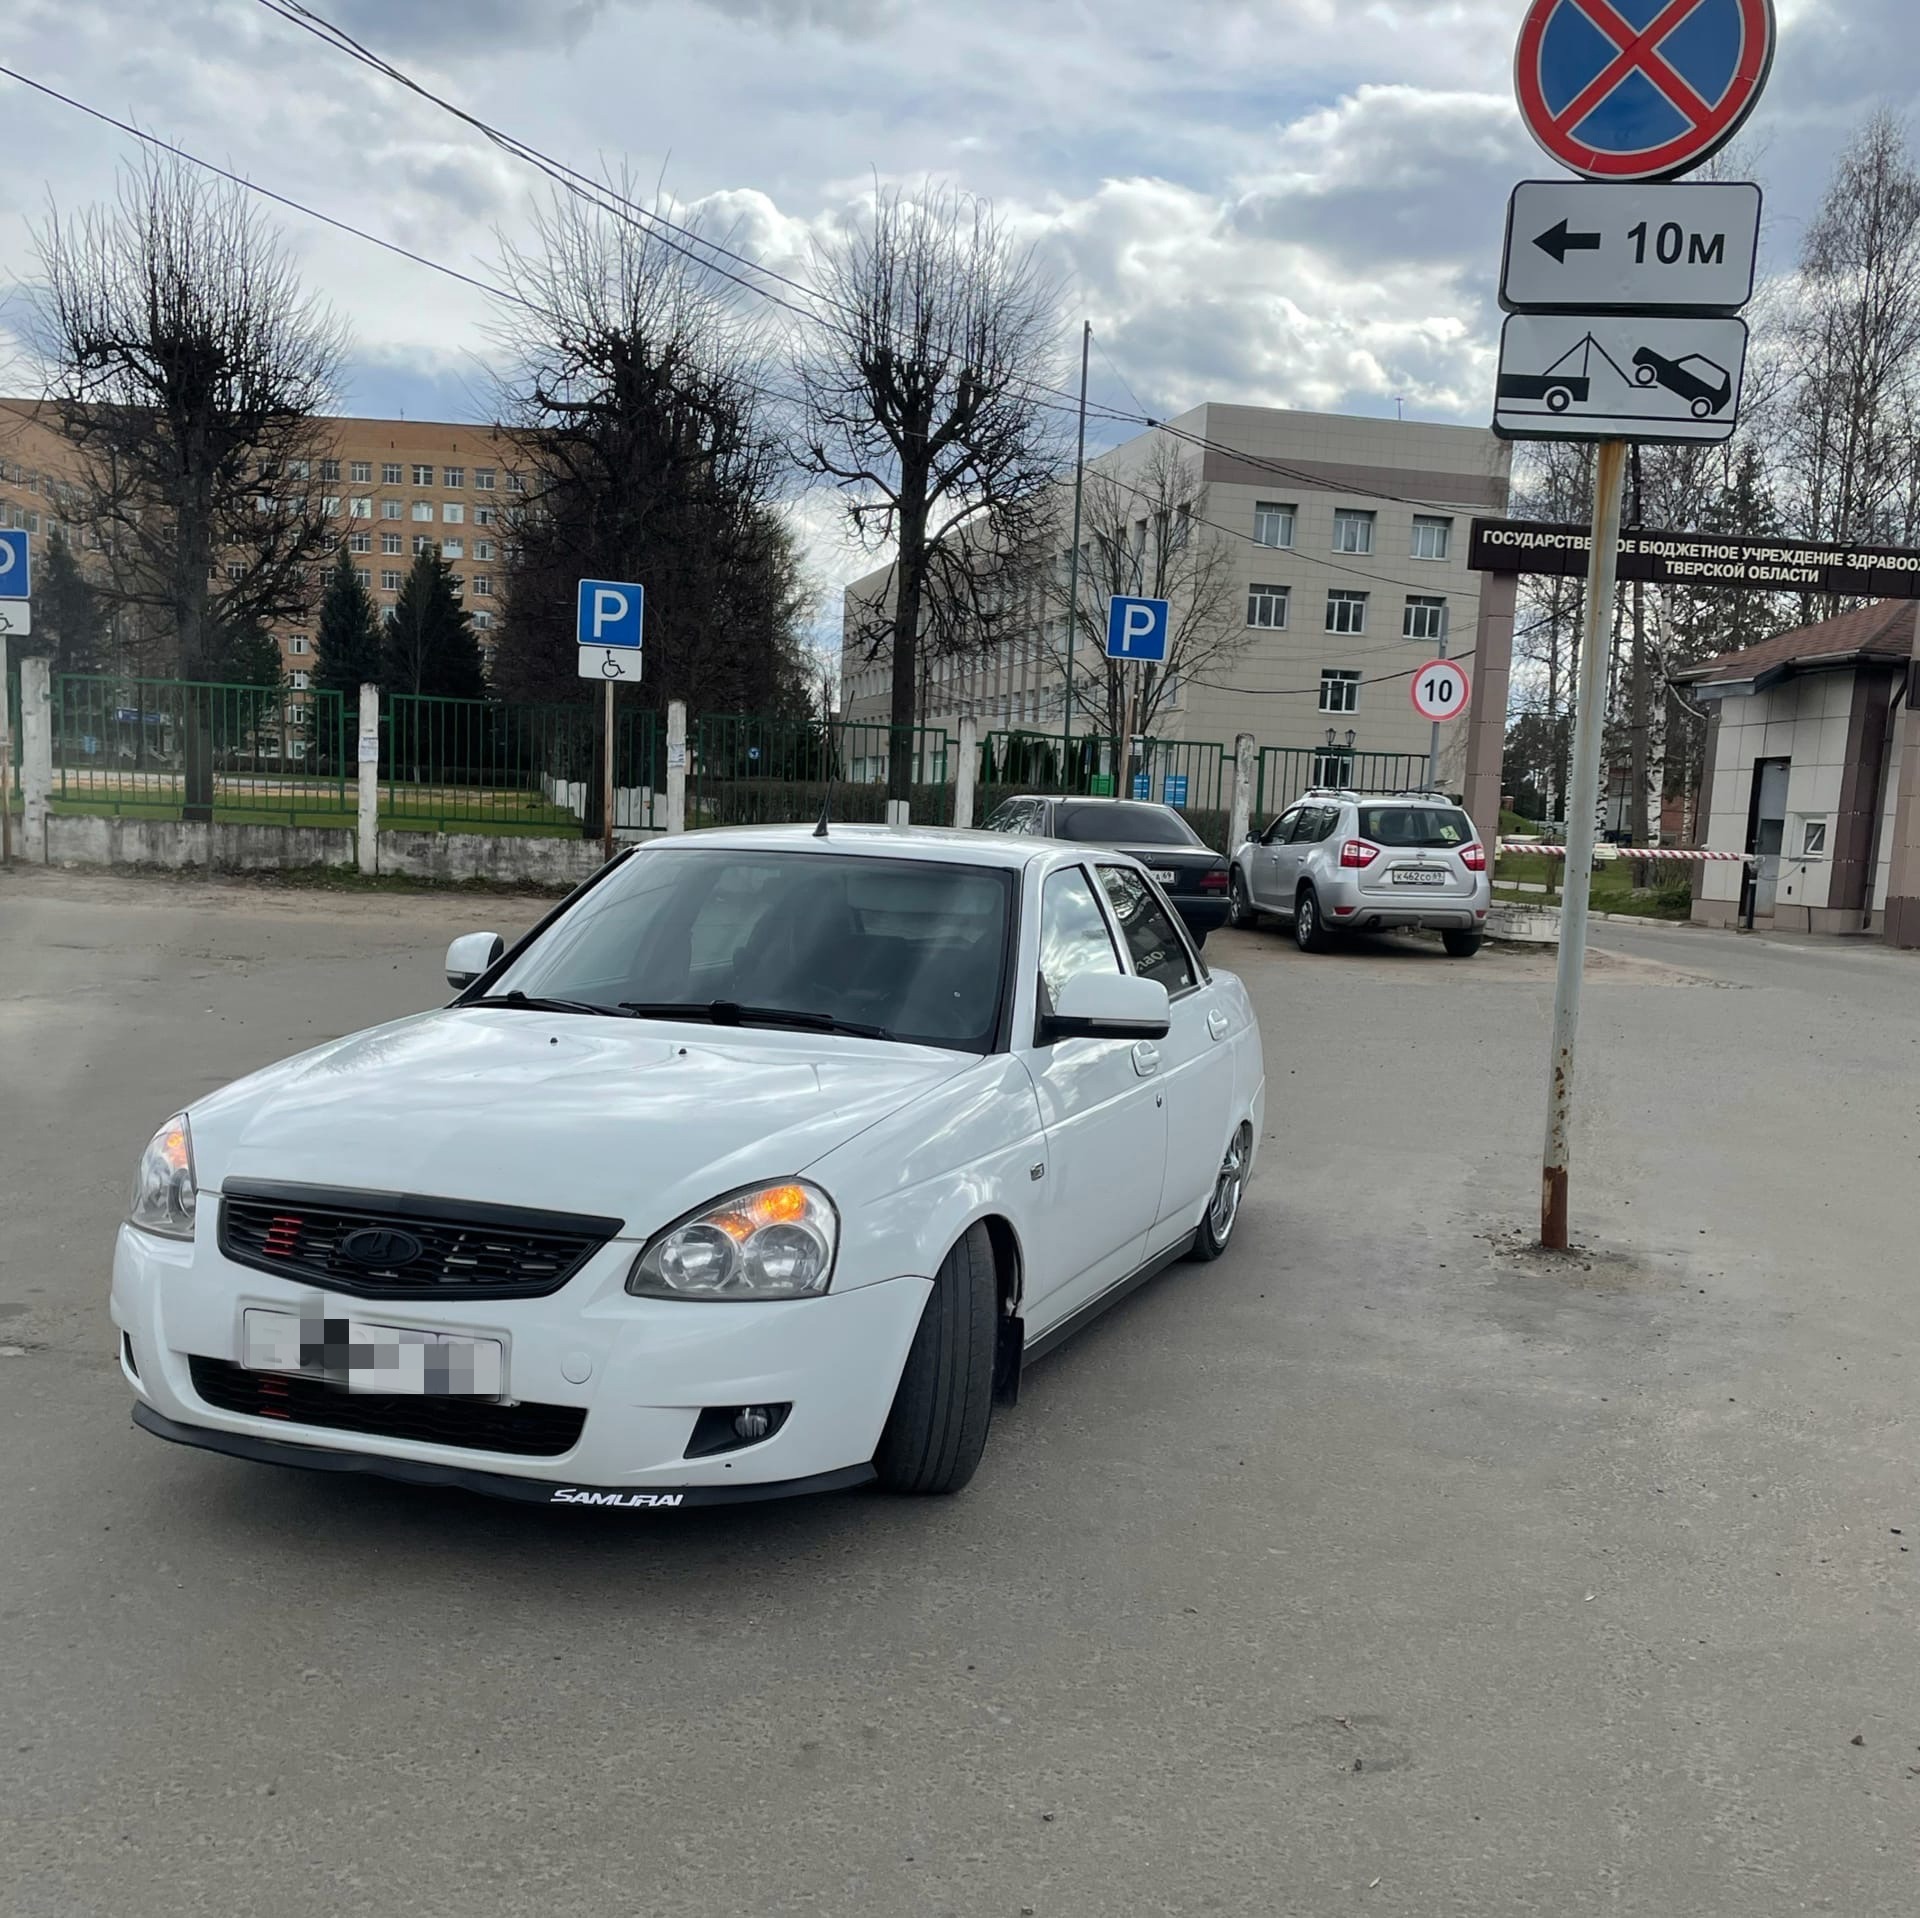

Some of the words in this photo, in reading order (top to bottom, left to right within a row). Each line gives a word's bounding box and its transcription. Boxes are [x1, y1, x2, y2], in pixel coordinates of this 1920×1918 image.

[1482, 530, 1636, 553] ГОСУДАРСТВЕОЕ
[1639, 540, 1739, 560] БЮДЖЕТНОЕ
[1742, 546, 1844, 567] УЧРЕЖДЕНИЕ
[1846, 553, 1920, 573] ЗДРАВОО
[1665, 560, 1745, 580] ТВЕРСКОЙ
[1748, 565, 1819, 583] ОБЛАСТИ
[593, 589, 628, 638] P
[1122, 604, 1156, 651] P
[1425, 679, 1452, 703] 10
[550, 1488, 684, 1507] SAMURAI
